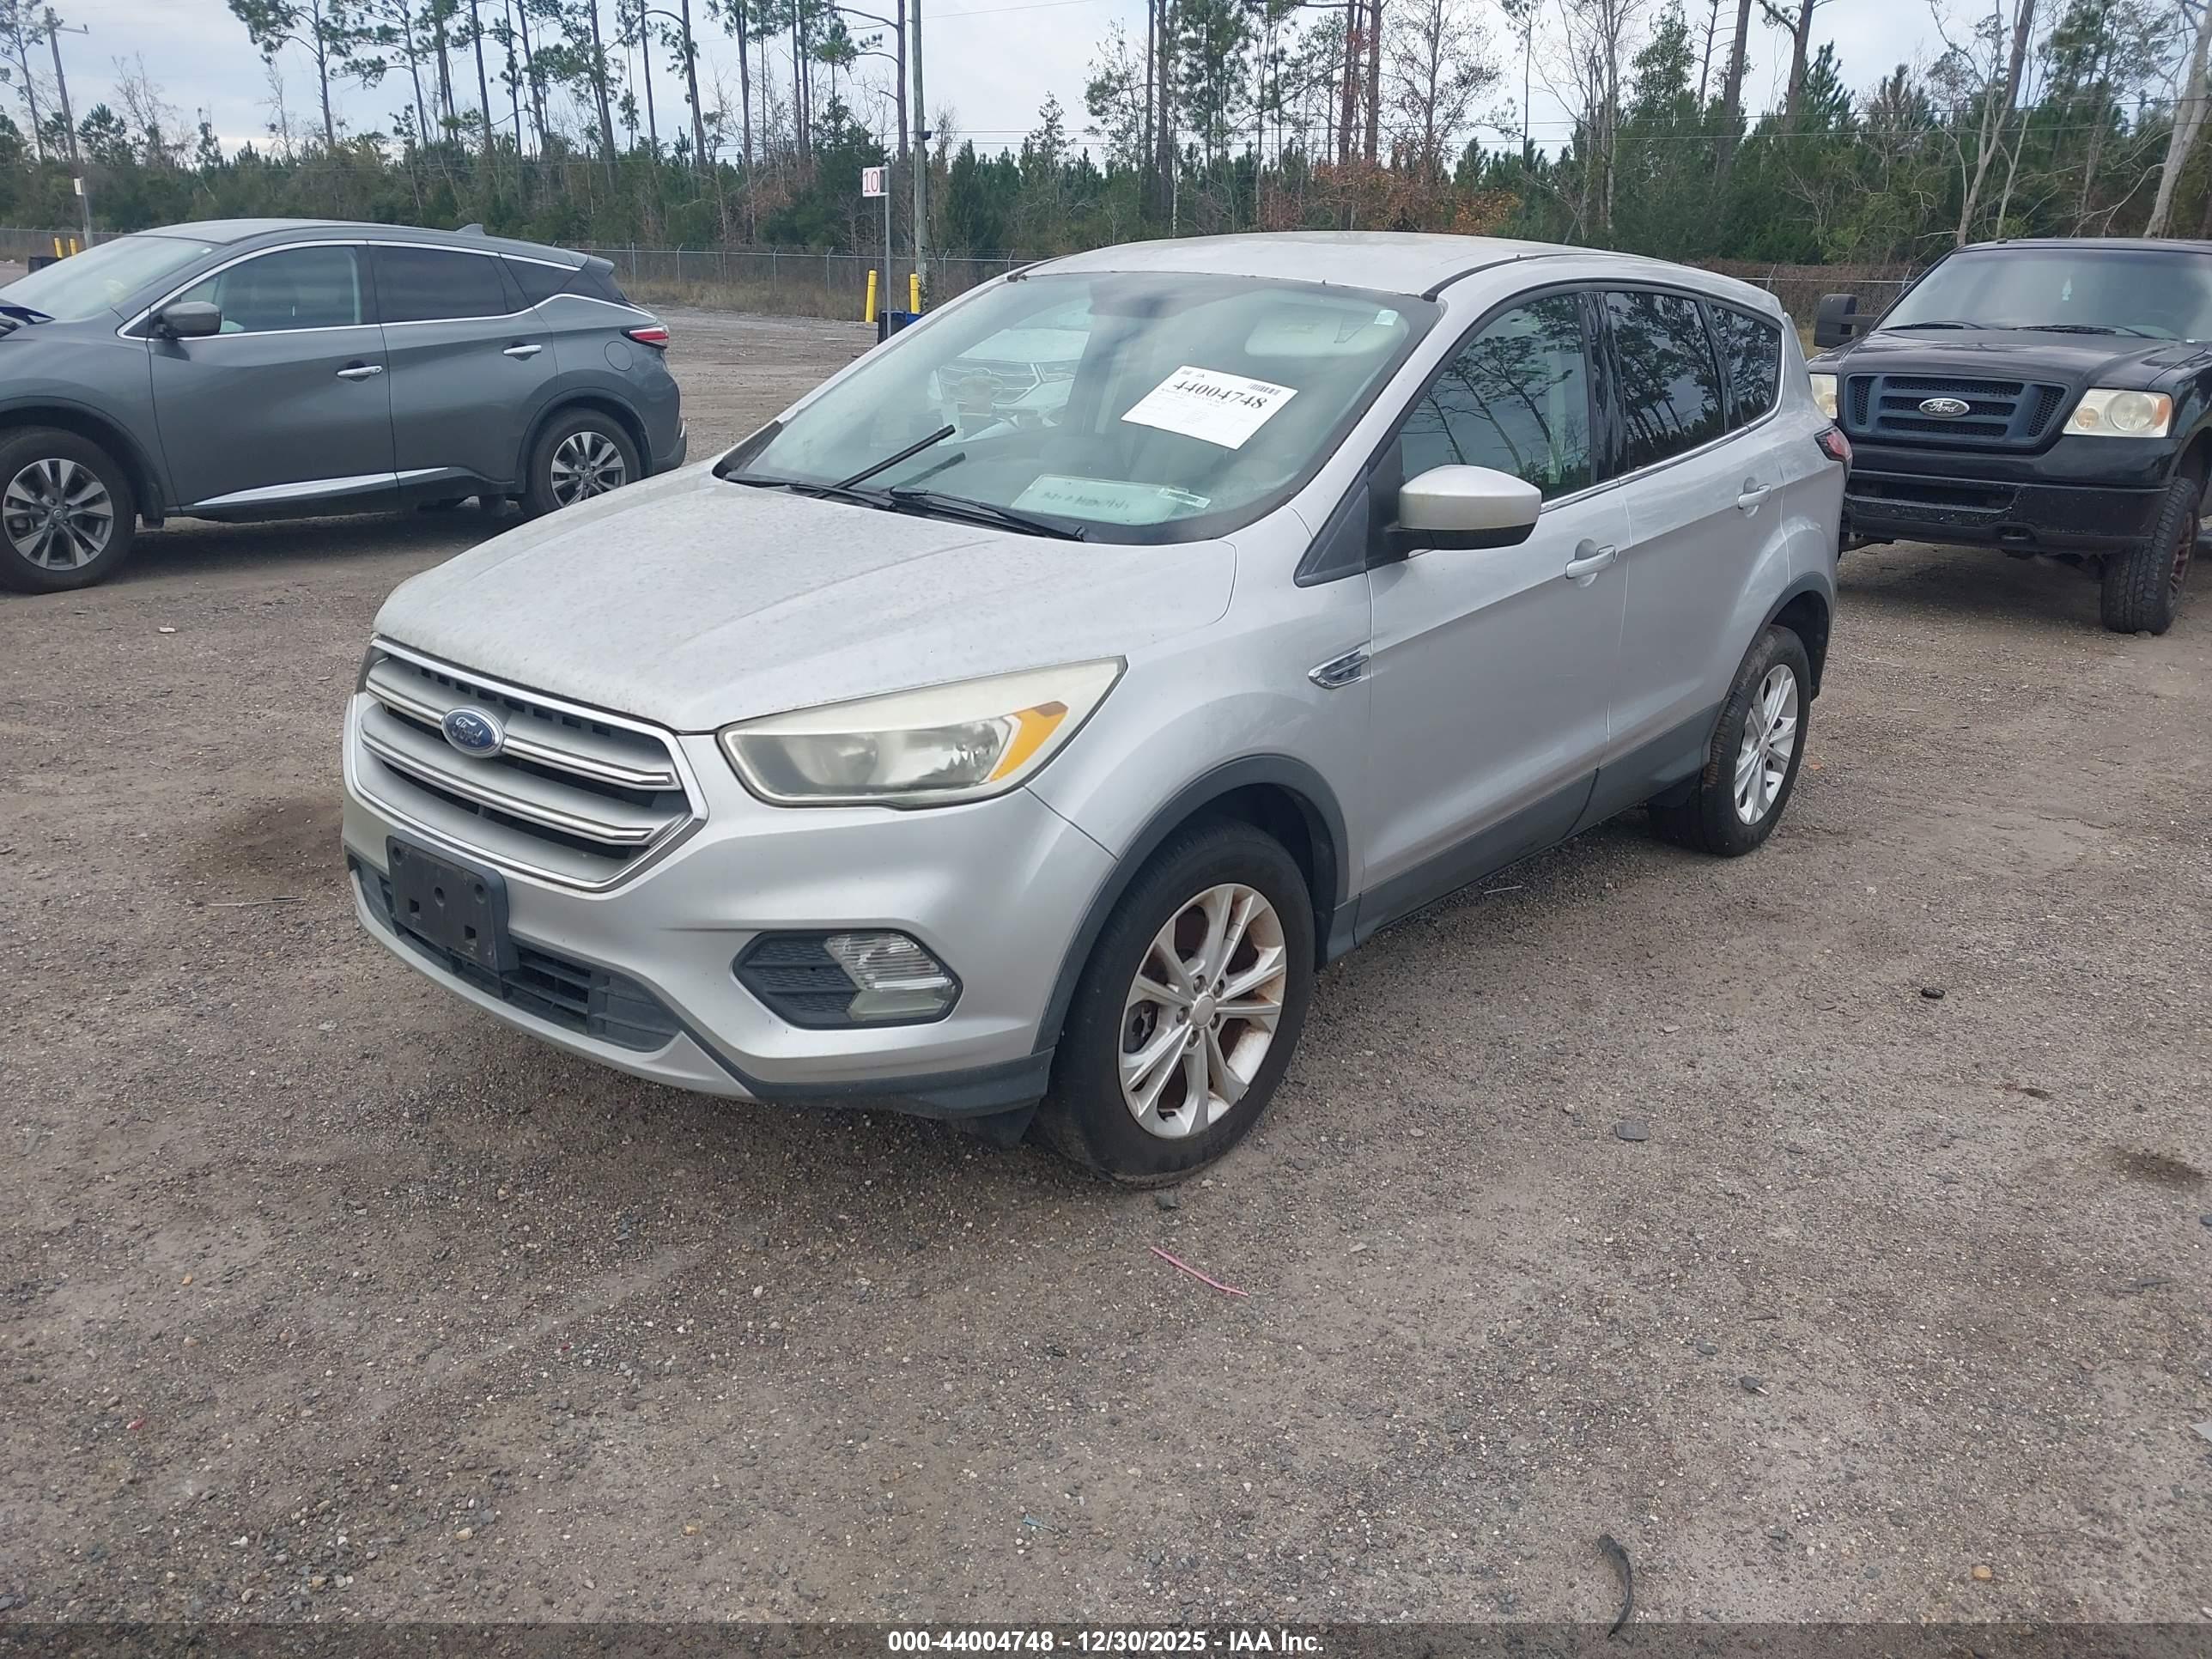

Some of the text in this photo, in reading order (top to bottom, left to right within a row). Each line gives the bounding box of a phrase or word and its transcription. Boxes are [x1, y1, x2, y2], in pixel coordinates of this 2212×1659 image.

[864, 171, 879, 192] 10
[1172, 380, 1268, 410] 44004748
[1927, 399, 1960, 413] Ford
[451, 716, 484, 745] Ford
